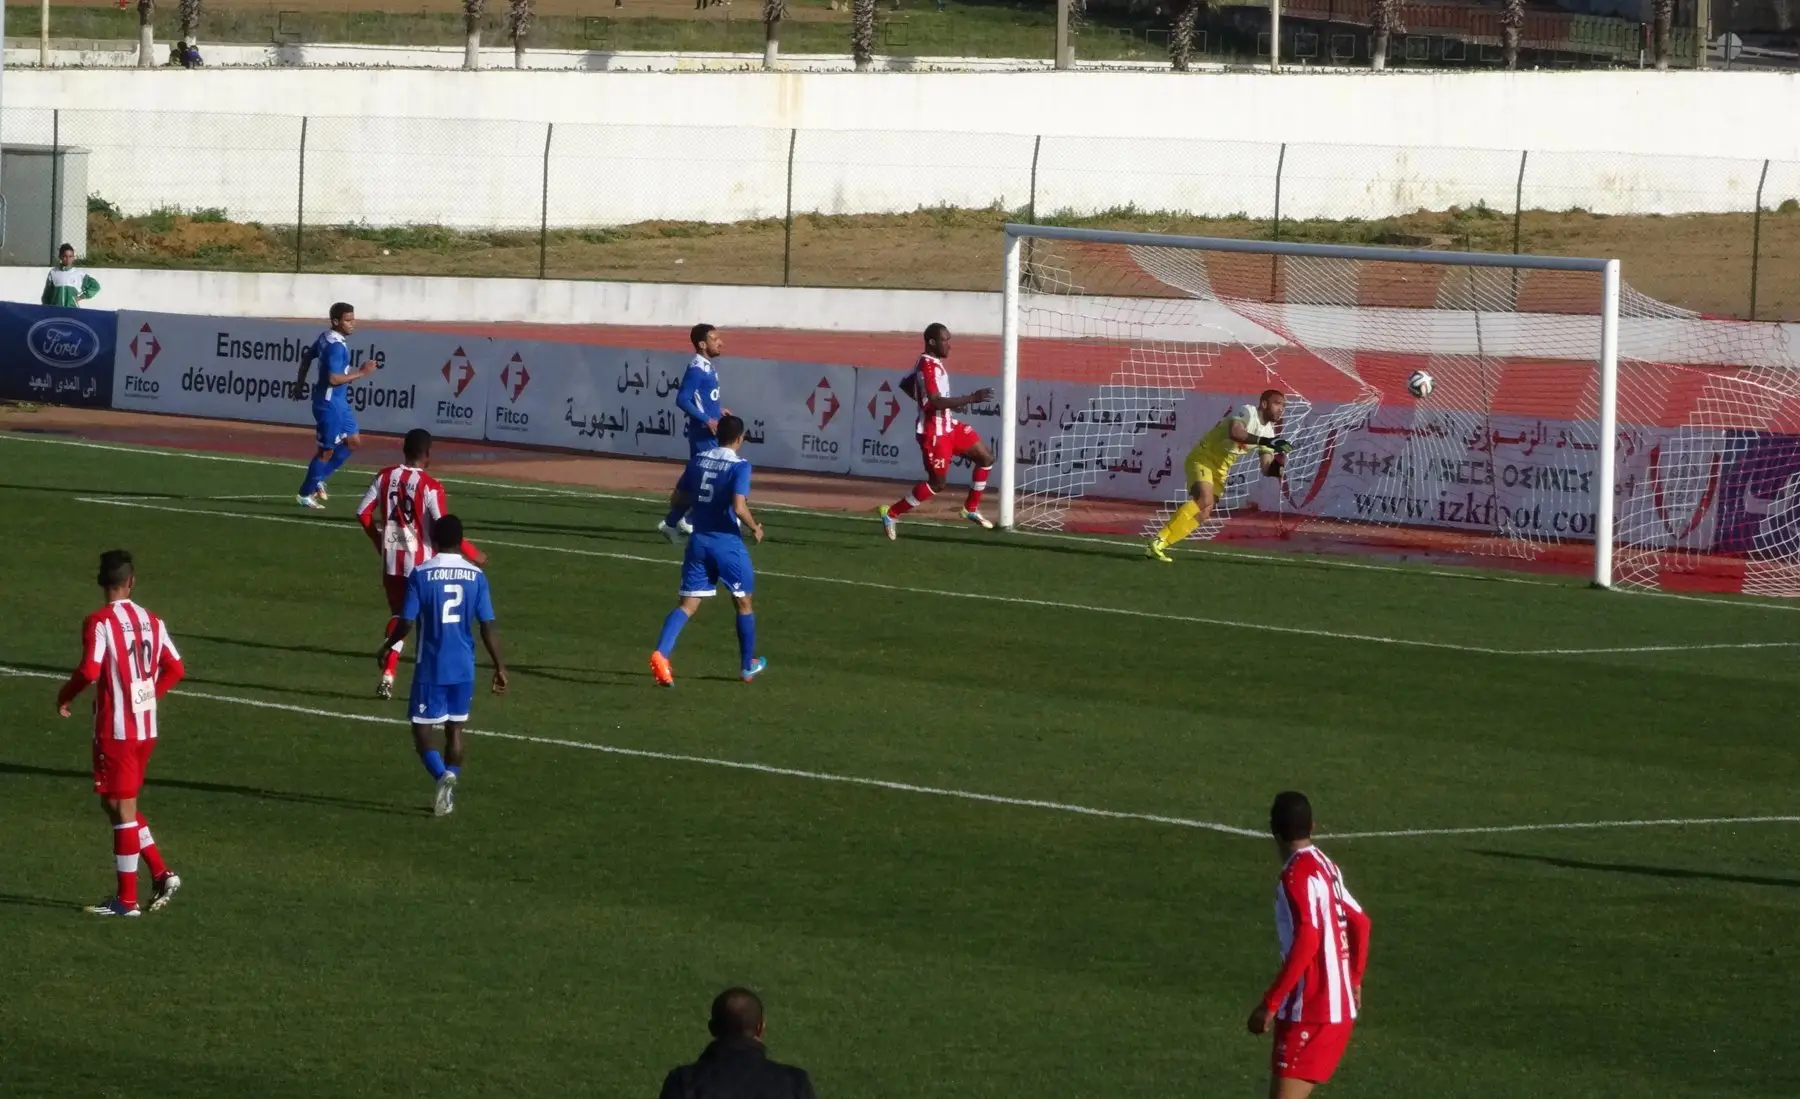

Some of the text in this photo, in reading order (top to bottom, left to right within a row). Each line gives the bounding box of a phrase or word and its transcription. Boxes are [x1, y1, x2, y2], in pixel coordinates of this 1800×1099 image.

[42, 328, 82, 356] Ford
[125, 375, 160, 393] Fitco
[437, 400, 474, 419] Fitco
[495, 406, 529, 425] Fitco
[1018, 394, 1053, 428] أجل
[802, 434, 838, 454] Fitco
[862, 438, 899, 458] Fitco
[933, 458, 945, 469] 21
[1147, 448, 1173, 488] في
[698, 470, 718, 503] 5
[388, 492, 415, 525] 29
[427, 570, 477, 582] T.COULIBALY
[442, 584, 464, 624] 2
[129, 639, 153, 680] 10
